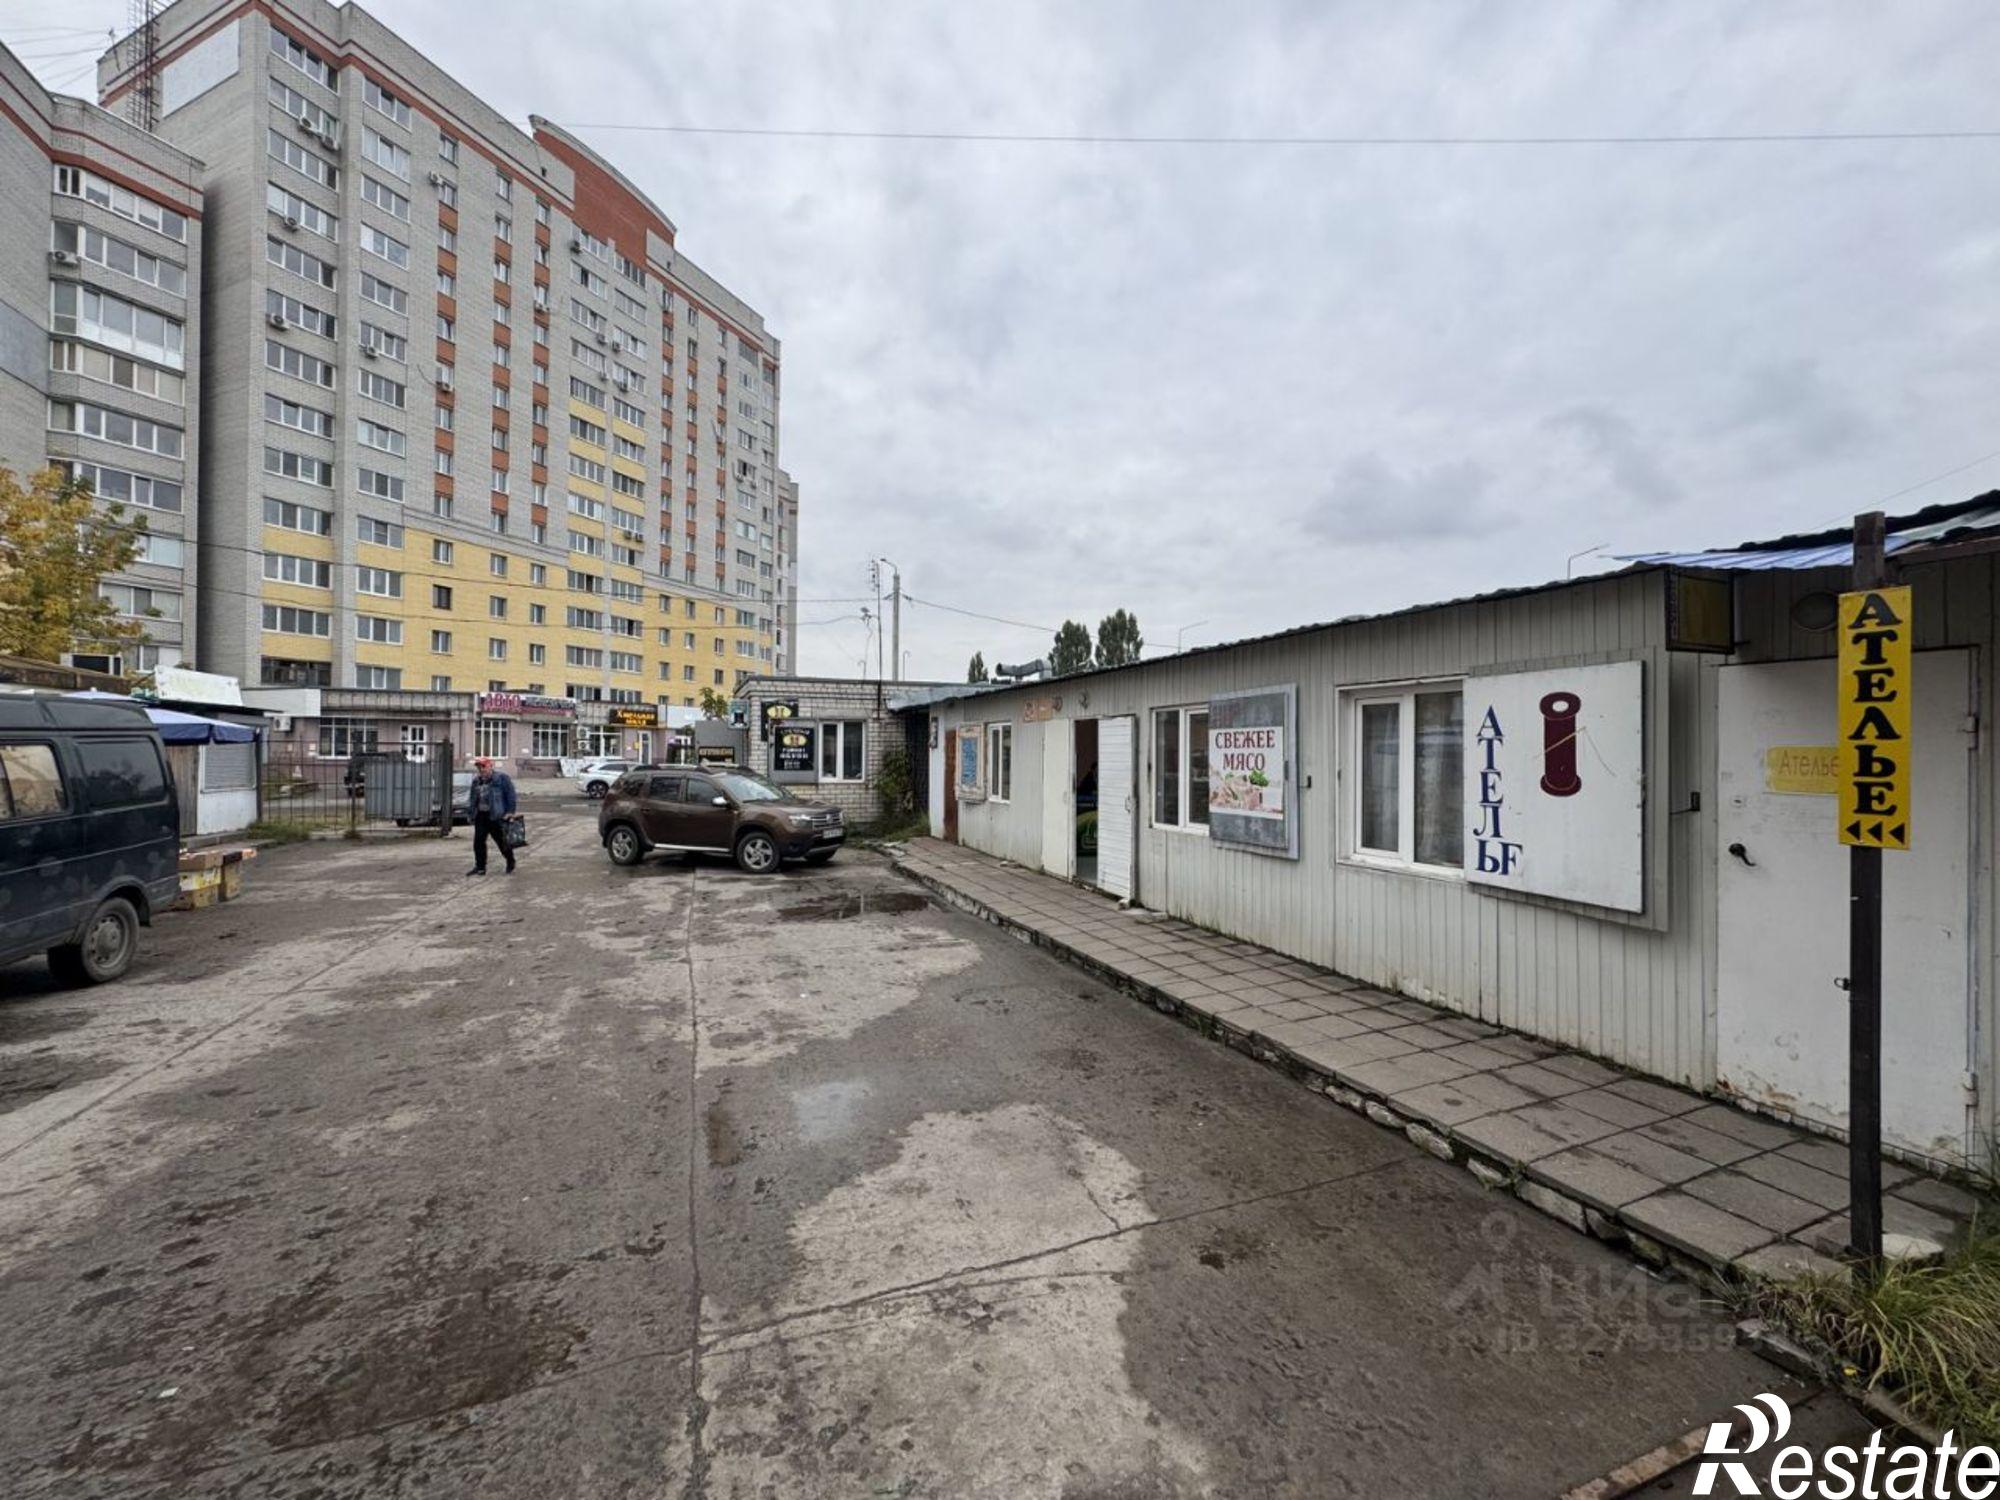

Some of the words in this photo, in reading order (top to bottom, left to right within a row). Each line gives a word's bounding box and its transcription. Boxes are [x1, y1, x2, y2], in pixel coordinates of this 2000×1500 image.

[1847, 593, 1902, 817] АТЕЛЬЕ
[1215, 729, 1276, 750] СВЕЖЕЕ
[1222, 752, 1266, 771] МЯСО
[1778, 750, 1839, 777] Ателье
